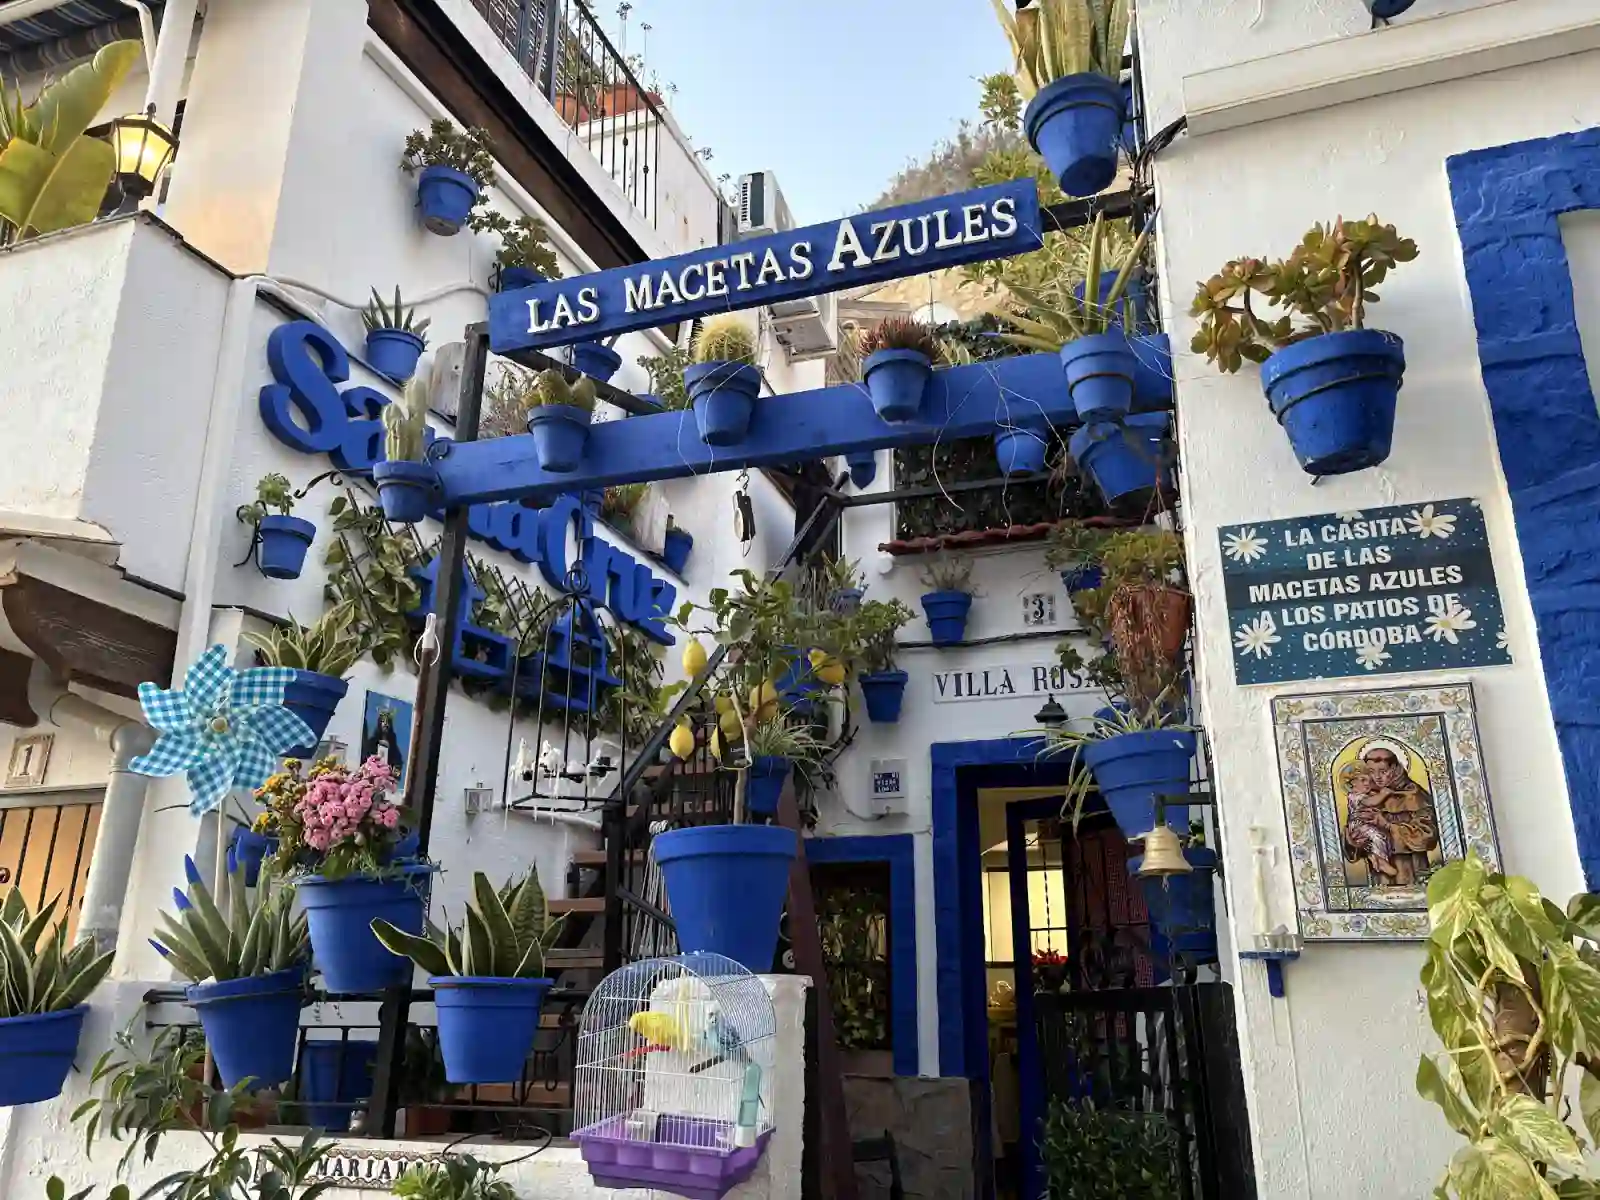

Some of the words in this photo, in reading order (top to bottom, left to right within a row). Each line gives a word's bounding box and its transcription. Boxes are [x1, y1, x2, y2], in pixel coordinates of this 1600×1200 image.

[525, 287, 600, 334] LAS
[623, 240, 814, 314] MACETAS
[826, 197, 1018, 272] AZULES
[1284, 526, 1314, 547] LA
[1321, 517, 1408, 543] CASITA
[1306, 550, 1338, 571] DE
[1344, 545, 1392, 567] LAS
[1249, 574, 1361, 604] MACETAS
[1368, 565, 1463, 592] AZULES
[1032, 598, 1044, 620] 3
[1260, 610, 1276, 630] A
[1281, 604, 1326, 626] LOS
[1333, 596, 1419, 622] PATIOS
[1427, 593, 1460, 614] DE
[1302, 624, 1423, 652] CÓRDOBA
[934, 668, 1016, 698] VILLA
[20, 744, 33, 776] 1
